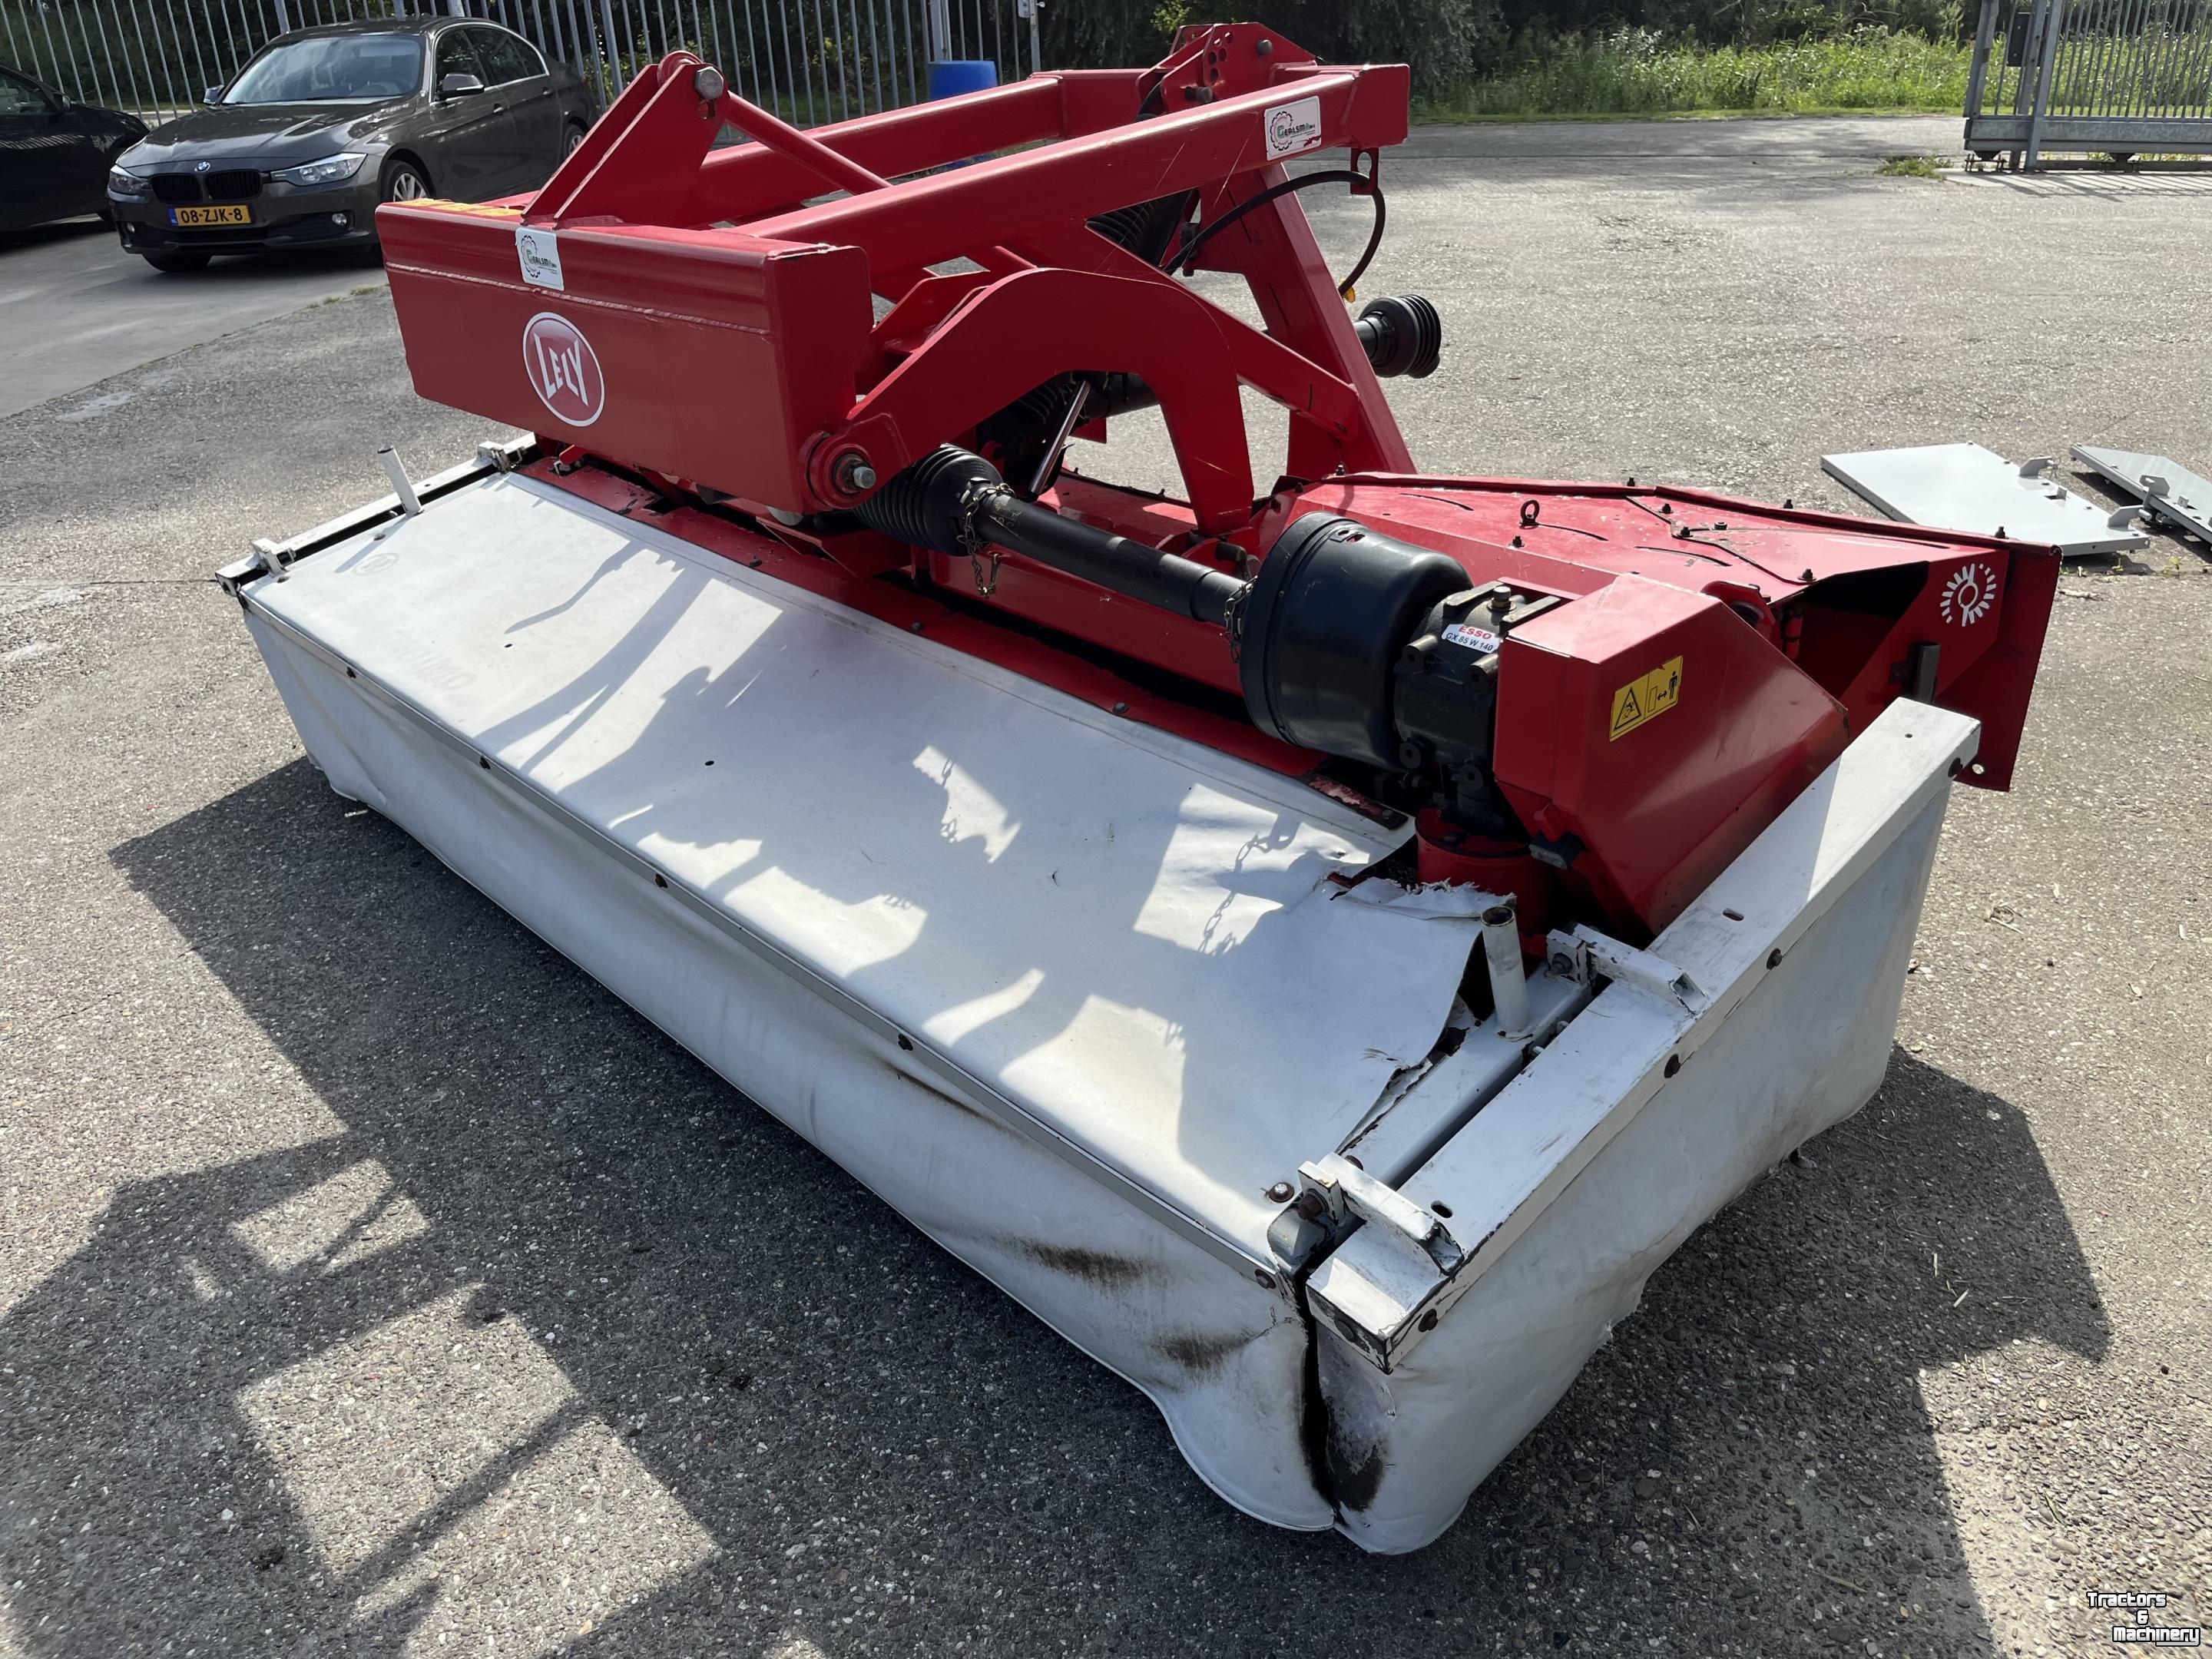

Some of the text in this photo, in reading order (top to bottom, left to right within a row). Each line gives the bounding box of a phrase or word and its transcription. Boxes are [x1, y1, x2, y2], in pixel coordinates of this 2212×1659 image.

[180, 207, 243, 224] 08-ZJK-8
[534, 333, 589, 407] LELY
[1446, 632, 1459, 641] GX
[1459, 636, 1468, 644] 85
[1481, 642, 1493, 651] 140
[1459, 625, 1492, 640] ESSO
